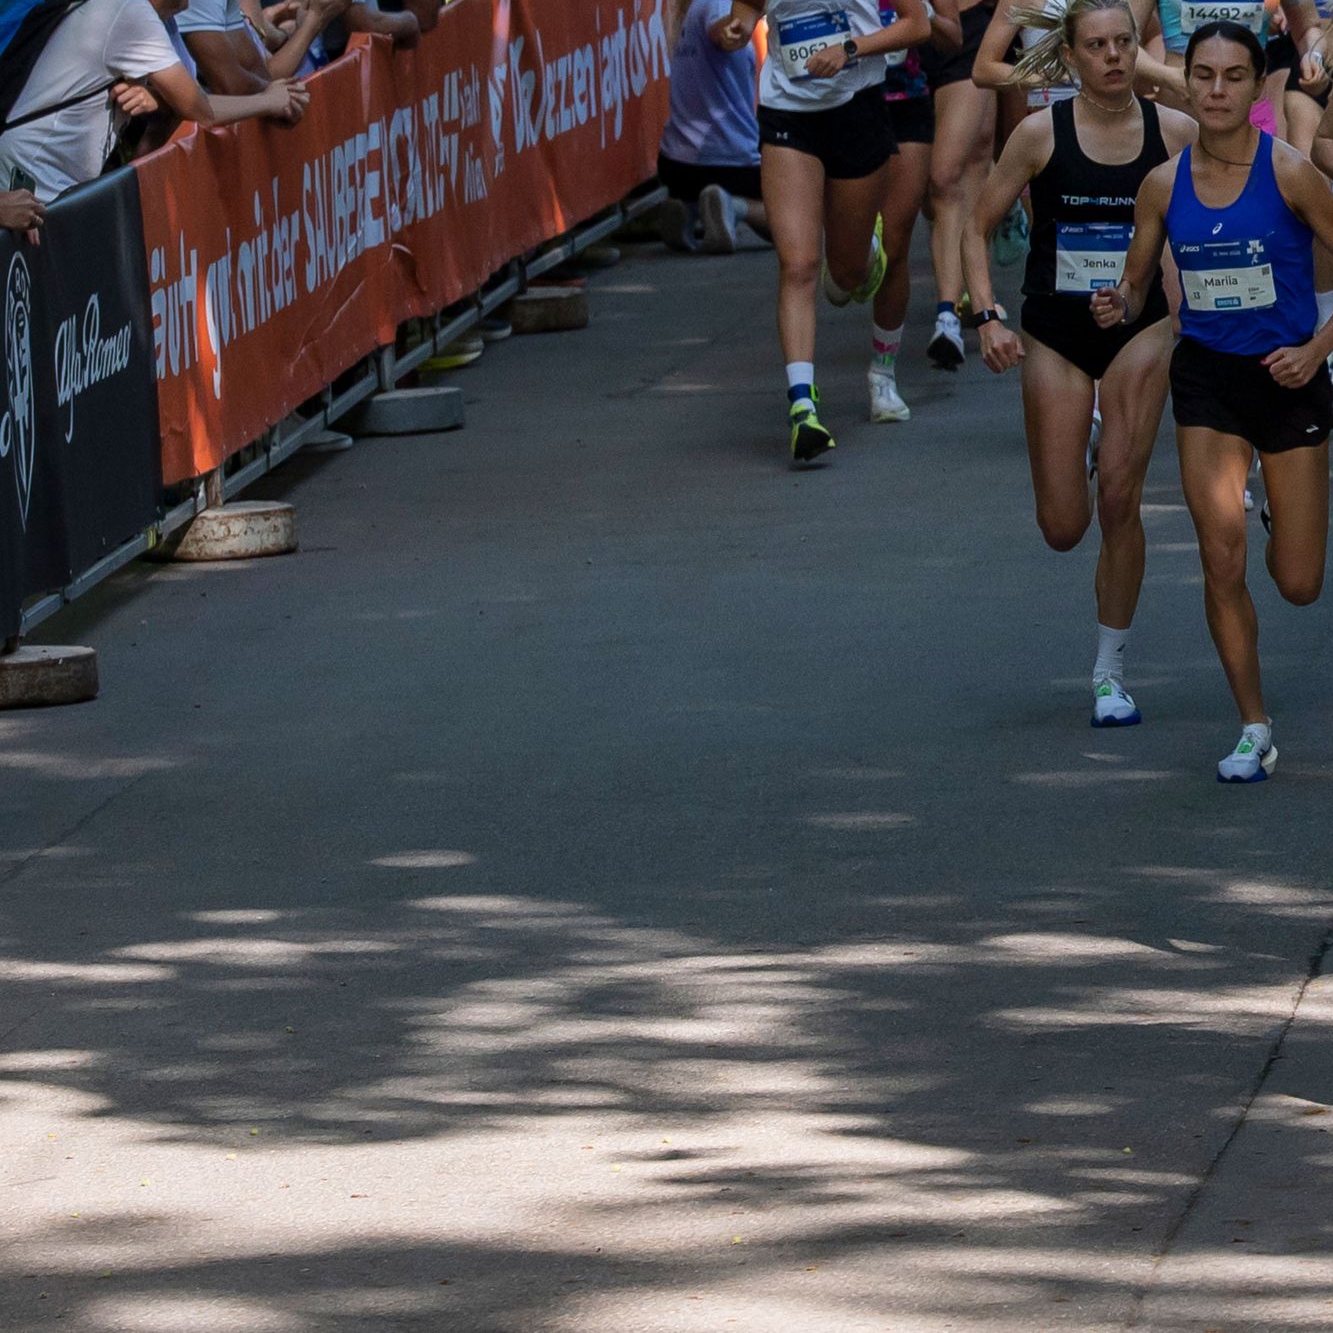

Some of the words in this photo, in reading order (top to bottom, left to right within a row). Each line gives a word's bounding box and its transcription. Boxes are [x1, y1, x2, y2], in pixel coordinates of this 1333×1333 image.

[1189, 7, 1241, 20] 14492
[1082, 258, 1117, 269] Jenka
[1203, 275, 1239, 288] Mariia
[205, 226, 237, 401] gut
[272, 176, 300, 311] der
[54, 312, 83, 444] Alfa
[82, 292, 132, 391] Romeo
